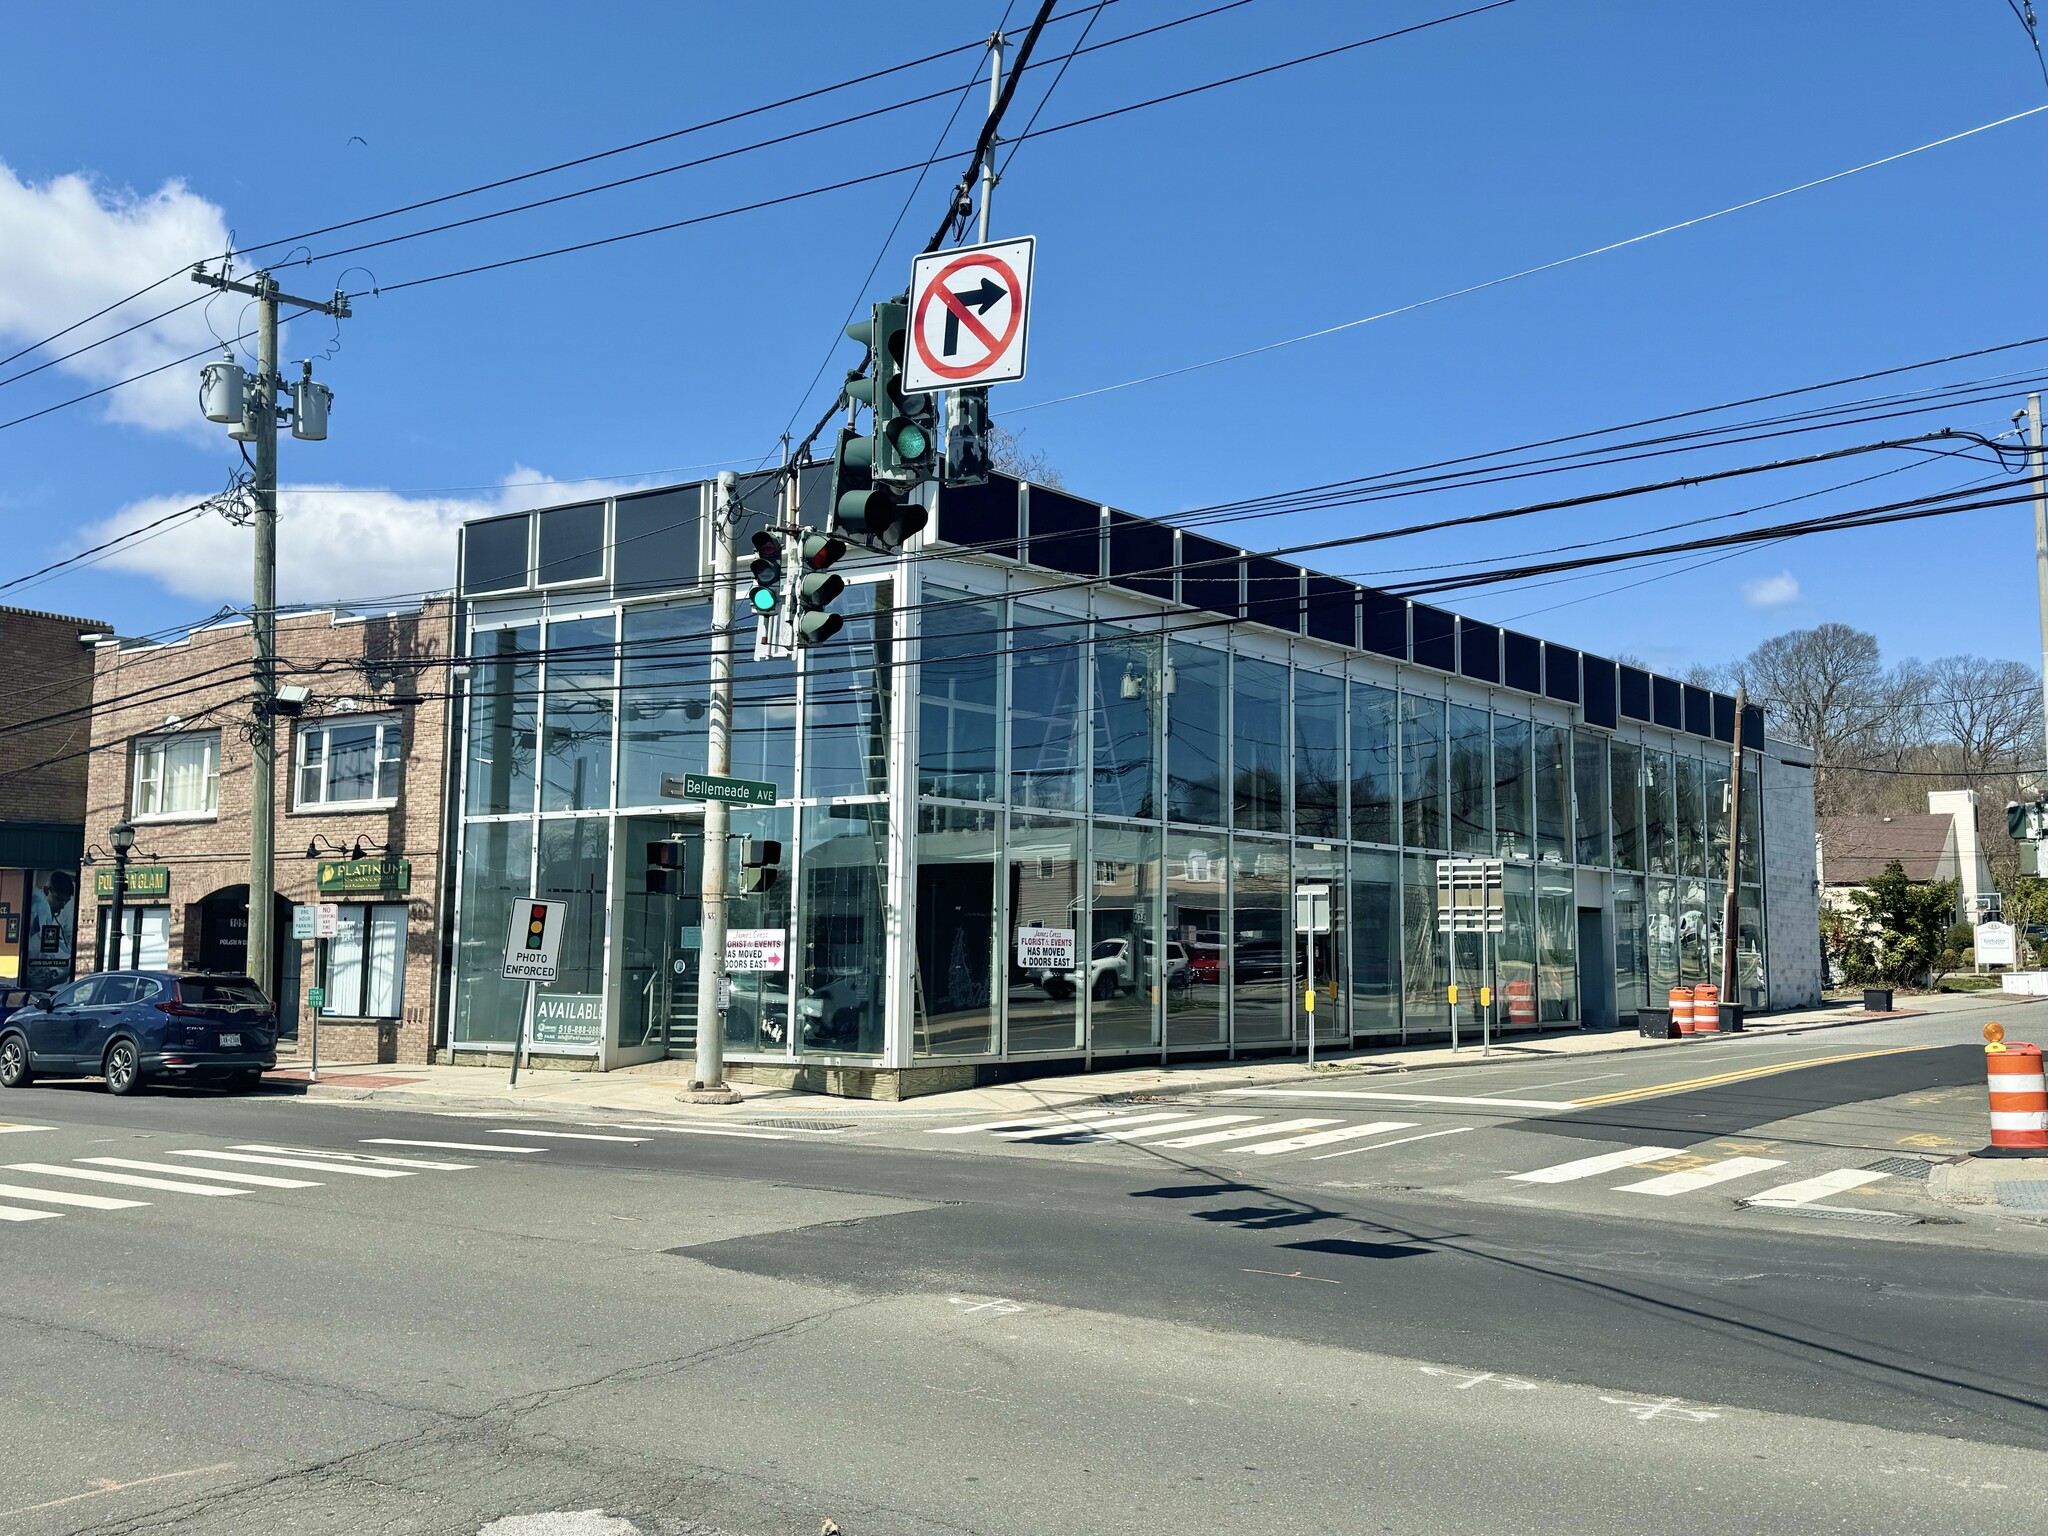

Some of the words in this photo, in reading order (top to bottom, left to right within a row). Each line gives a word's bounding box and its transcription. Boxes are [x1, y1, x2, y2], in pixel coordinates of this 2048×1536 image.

[687, 779, 750, 799] Bellemeade
[757, 789, 774, 801] AVE
[337, 863, 403, 876] PLATINUM
[138, 873, 164, 889] GLAM
[727, 940, 747, 948] ORIST
[754, 940, 781, 948] EVENTS
[1021, 938, 1045, 946] FLORIST
[1051, 939, 1073, 947] EVENTS
[727, 950, 736, 958] AS
[738, 950, 763, 958] MOVED
[1027, 947, 1041, 956] HAS
[1042, 948, 1066, 957] MOVED
[516, 952, 548, 963] PHOTO
[1022, 957, 1027, 966] 4
[1029, 957, 1052, 966] DOORS
[1053, 958, 1070, 967] EAST
[749, 960, 767, 968] EAST
[505, 964, 555, 977] ENFORCED
